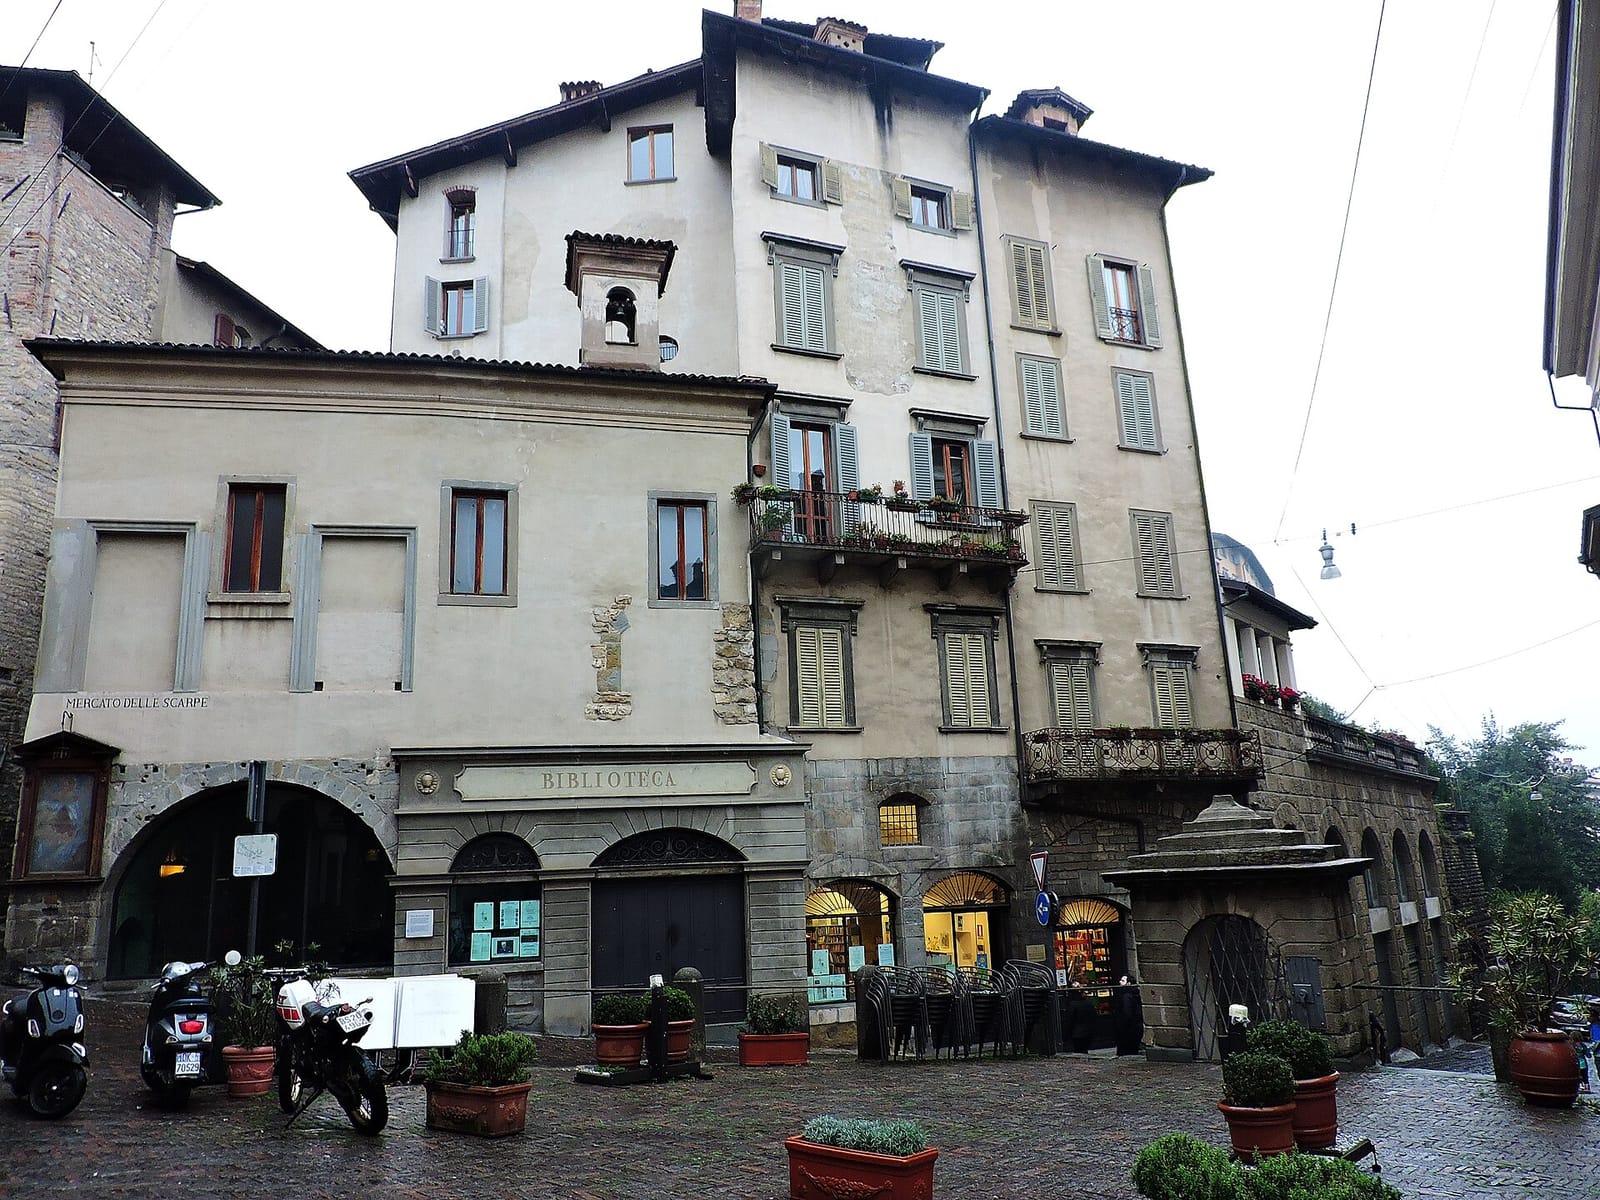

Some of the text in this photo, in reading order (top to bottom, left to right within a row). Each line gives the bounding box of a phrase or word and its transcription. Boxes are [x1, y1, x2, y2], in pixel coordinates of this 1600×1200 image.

[66, 697, 209, 709] MERCATO DELLE SCARPE
[541, 770, 677, 789] BIBLIOTECA
